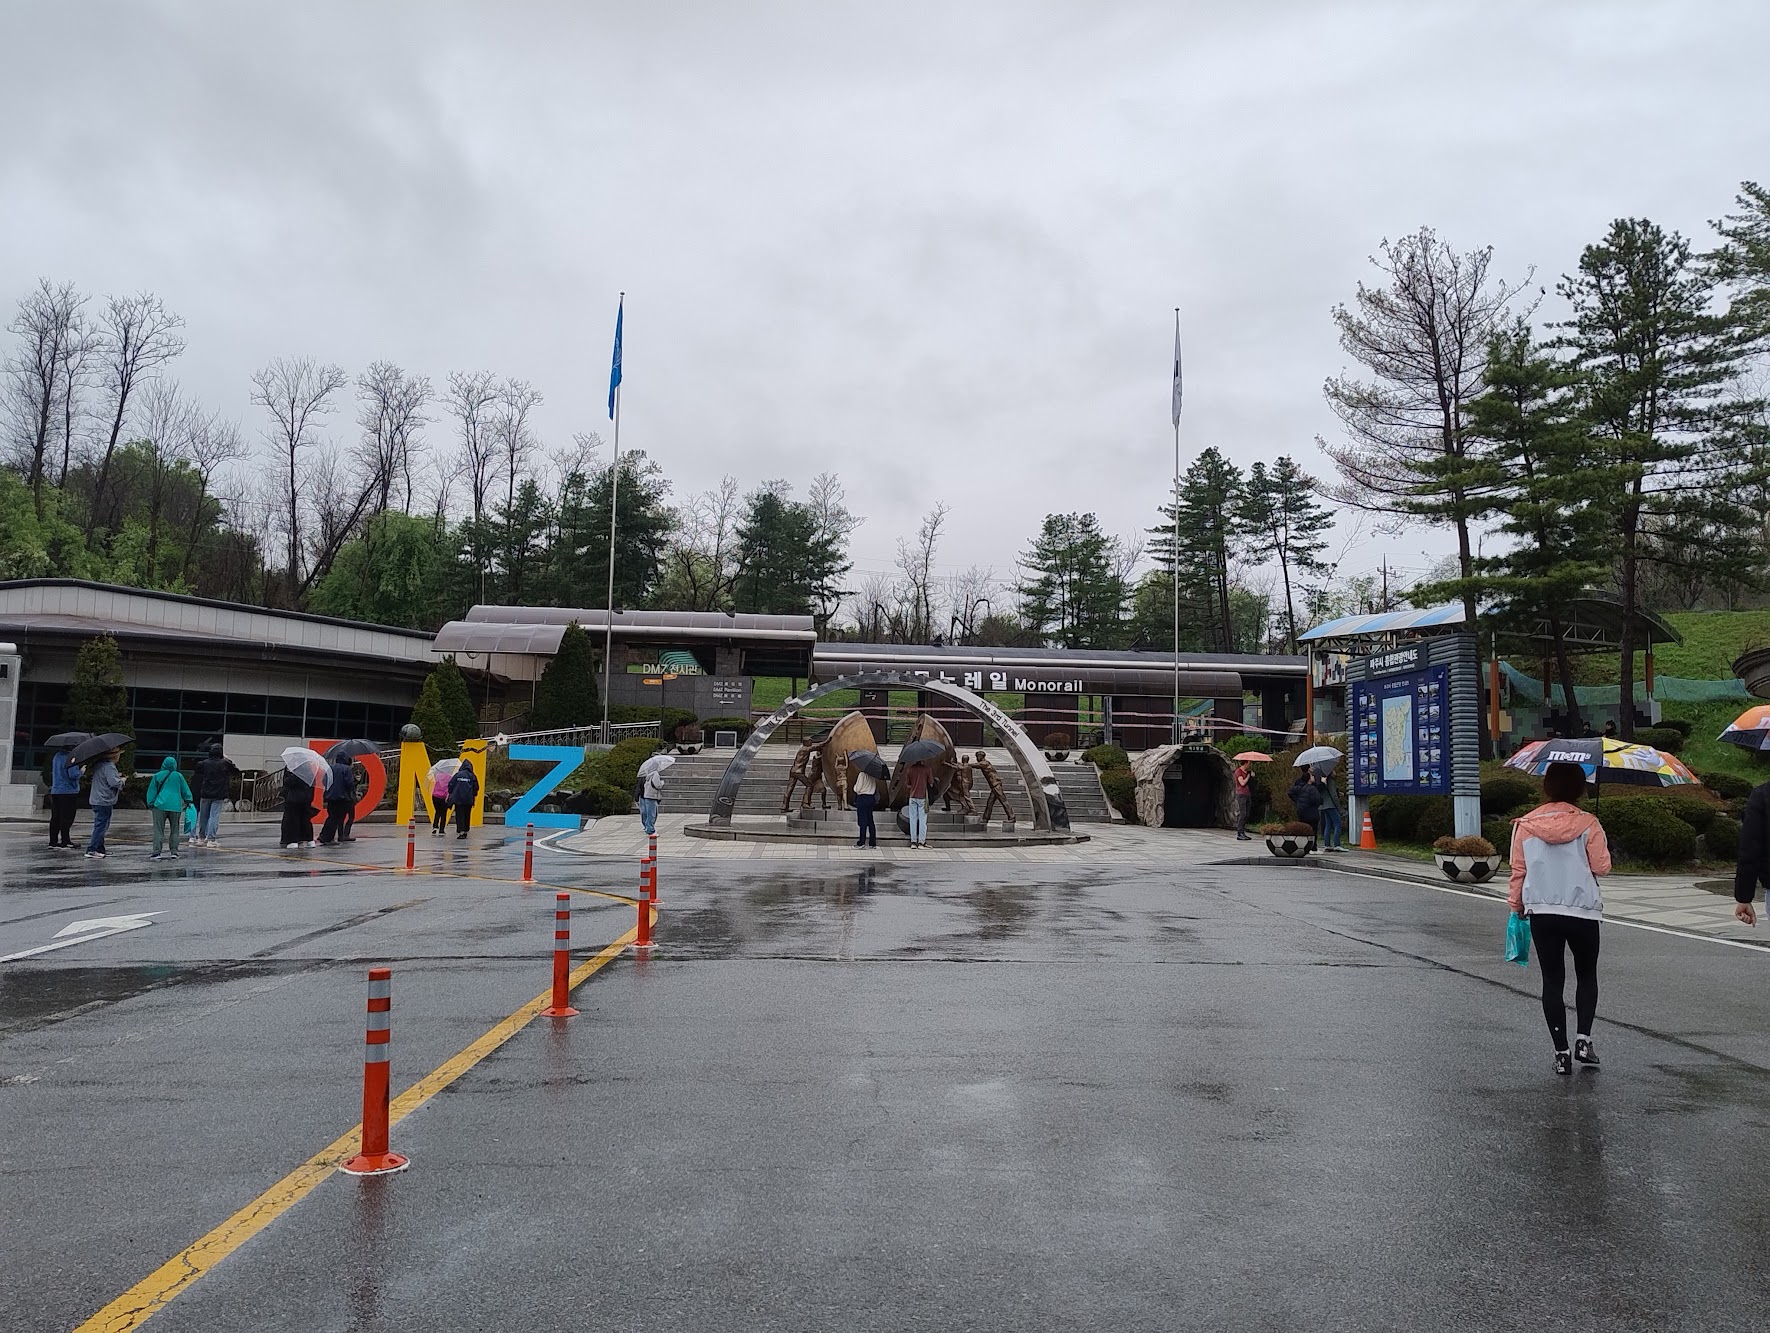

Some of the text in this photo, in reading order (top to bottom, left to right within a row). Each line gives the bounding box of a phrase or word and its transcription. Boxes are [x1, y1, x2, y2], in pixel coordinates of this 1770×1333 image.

[643, 664, 698, 675] DMZ 전시관
[1014, 677, 1084, 693] Monorail
[978, 700, 1020, 738] The 3rd Tunnel
[309, 739, 585, 829] DMZ
